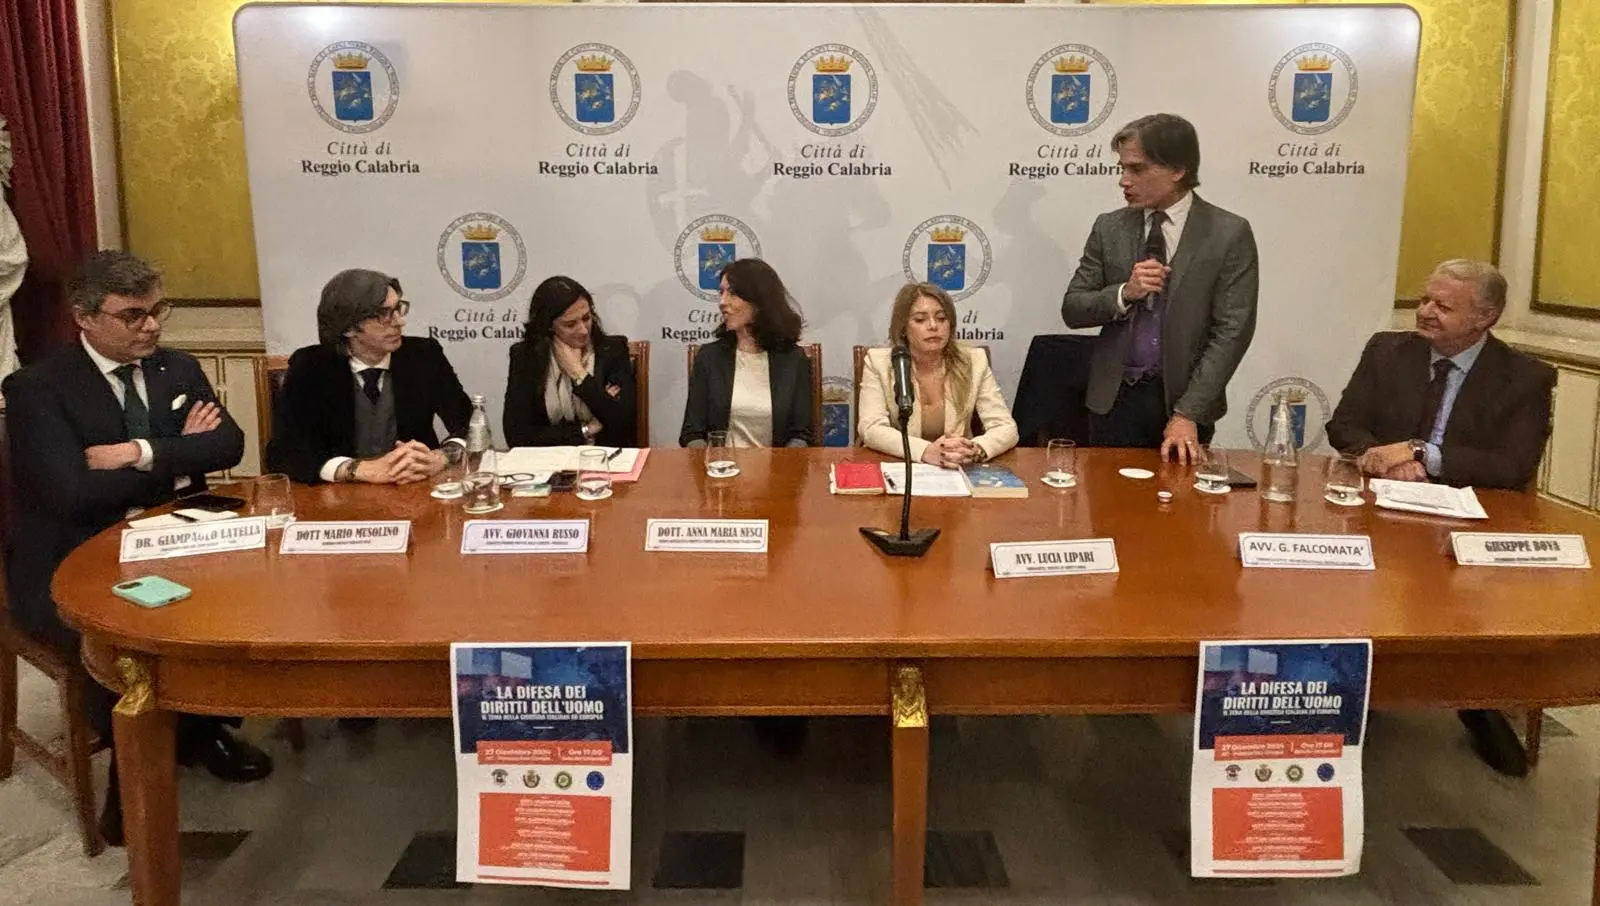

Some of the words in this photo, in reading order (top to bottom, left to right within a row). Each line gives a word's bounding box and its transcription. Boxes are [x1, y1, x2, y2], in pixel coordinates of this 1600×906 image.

[327, 141, 368, 156] Città
[375, 141, 391, 156] di
[565, 143, 608, 158] Città
[614, 143, 631, 158] di
[800, 144, 842, 159] Città
[849, 144, 865, 159] di
[1037, 144, 1079, 159] Città
[1086, 144, 1103, 158] di
[1277, 142, 1318, 157] Città
[1325, 142, 1341, 157] di
[301, 160, 351, 177] Reggio
[355, 160, 421, 174] Calabria
[539, 162, 589, 178] Reggio
[593, 162, 659, 176] Calabria
[773, 163, 823, 179] Reggio
[827, 163, 892, 177] Calabria
[1009, 162, 1059, 179] Reggio
[1248, 161, 1299, 178] Reggio
[1303, 161, 1365, 175] Calabria
[454, 308, 495, 323] Città
[502, 308, 518, 323] di
[962, 309, 978, 324] di
[428, 326, 477, 341] Reggio
[482, 325, 526, 339] Calab
[661, 326, 710, 343] Reggio
[956, 327, 1004, 340] alabria
[135, 537, 154, 549] DR.
[220, 524, 261, 539] LATELLA
[296, 529, 321, 541] DOTT
[323, 527, 353, 540] MARIO
[355, 526, 399, 538] MUSOLINO
[482, 528, 503, 539] AVV.
[506, 528, 550, 539] GIOVANNA
[552, 528, 579, 539] RUSSO
[657, 527, 684, 537] DOTT.
[686, 526, 708, 537] ANNA
[710, 527, 738, 538] MARIA
[740, 527, 763, 538] NESCI
[1249, 541, 1276, 552] AVV.
[1278, 543, 1291, 552] G.
[1484, 540, 1532, 552] GIUSEPPE
[1533, 540, 1561, 552] BOVA
[1016, 553, 1036, 565] AVV.
[1038, 552, 1062, 564] LUCIA
[1064, 551, 1095, 563] LIPARI
[496, 686, 513, 699] LA
[516, 685, 562, 699] DIFESA
[565, 685, 586, 699] DEI
[1240, 682, 1256, 695] LA
[1260, 682, 1303, 695] DIFESA
[1306, 681, 1328, 695] DEI
[480, 700, 528, 714] DIRITTI
[531, 700, 604, 714] DELL'UOMO
[1223, 696, 1269, 710] DIRITTI
[1272, 695, 1342, 709] DELL'UOMO
